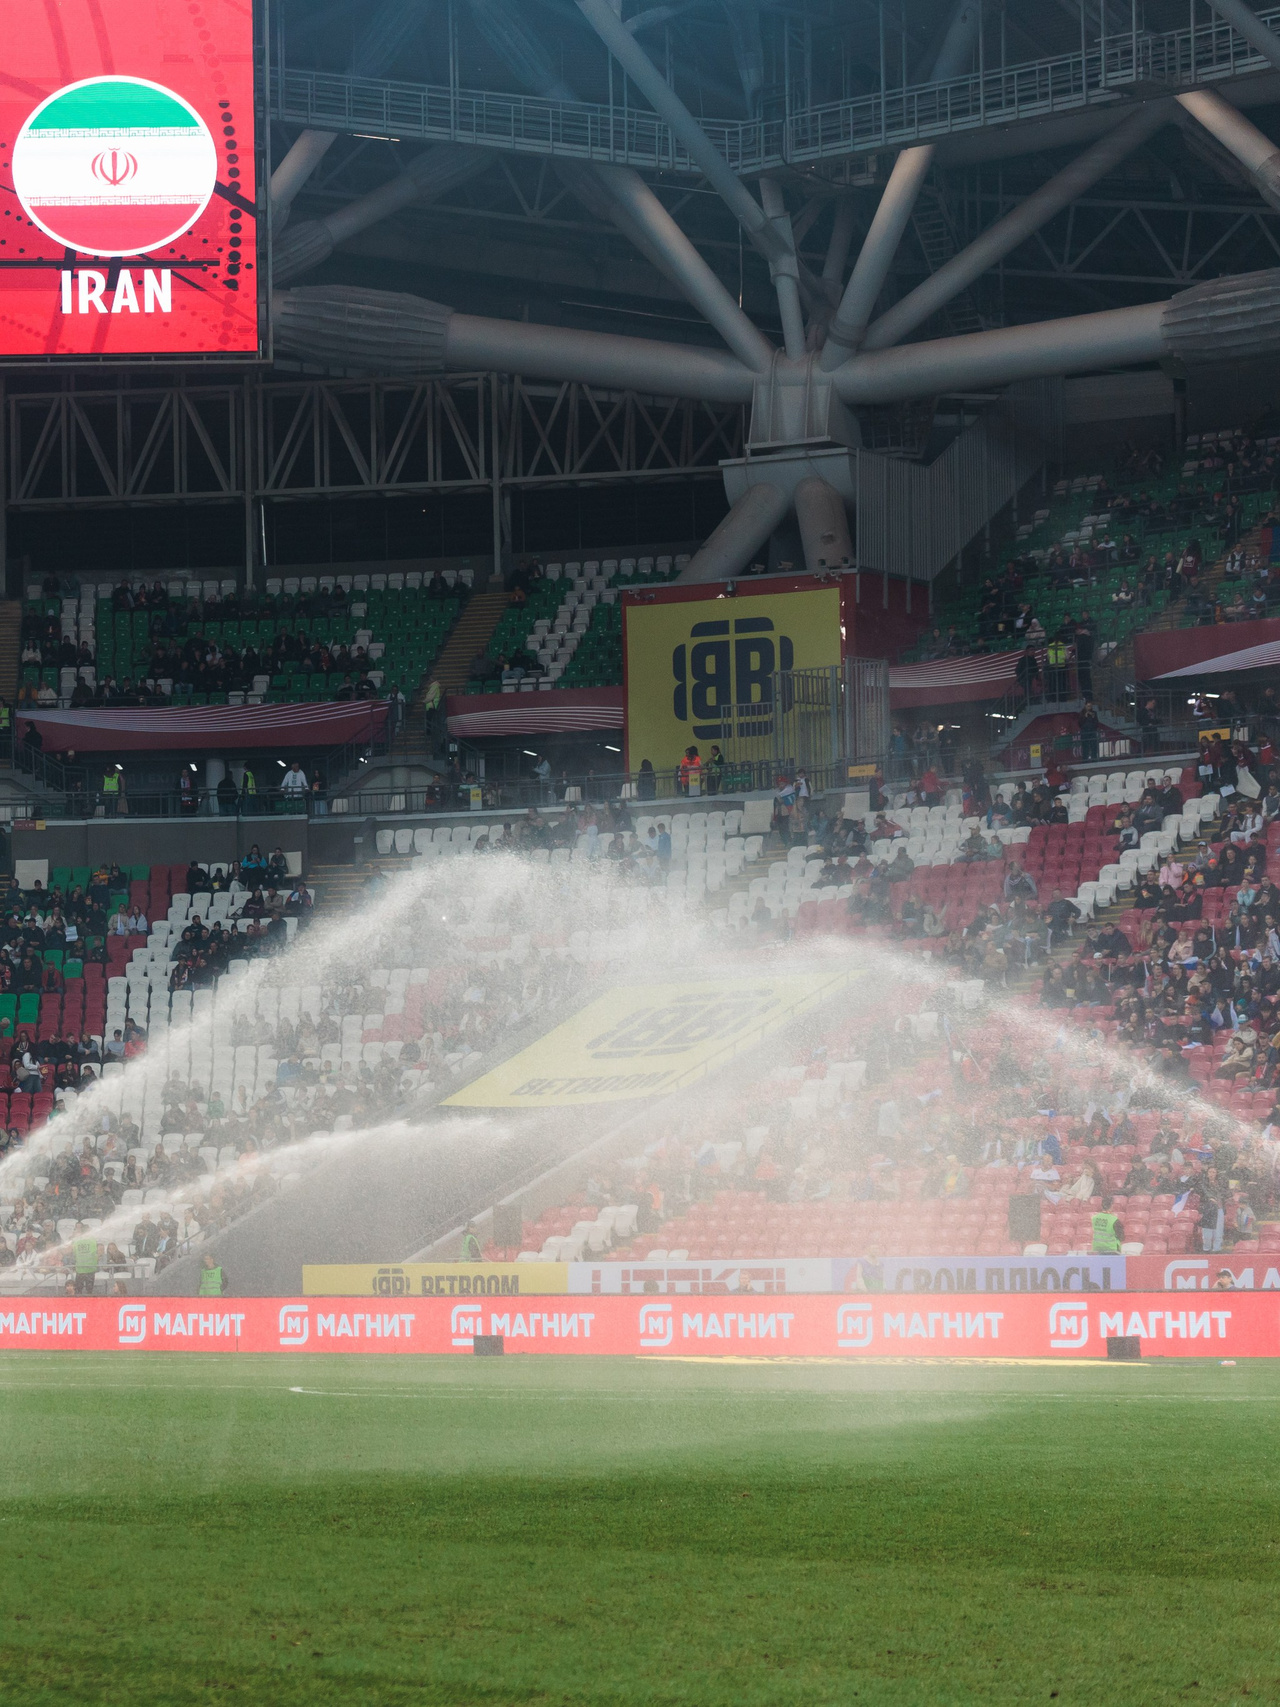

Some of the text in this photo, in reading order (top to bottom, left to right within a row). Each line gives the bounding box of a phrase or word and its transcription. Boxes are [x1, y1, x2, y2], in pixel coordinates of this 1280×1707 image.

[61, 269, 173, 314] IRAN
[154, 1313, 245, 1336] МАГНИТ
[317, 1314, 415, 1337] МАГНИТ
[491, 1313, 595, 1337] МАГНИТ
[682, 1313, 794, 1338] МАГНИТ
[883, 1312, 1004, 1338] МАГНИТ
[1100, 1311, 1232, 1338] МАГНИТ
